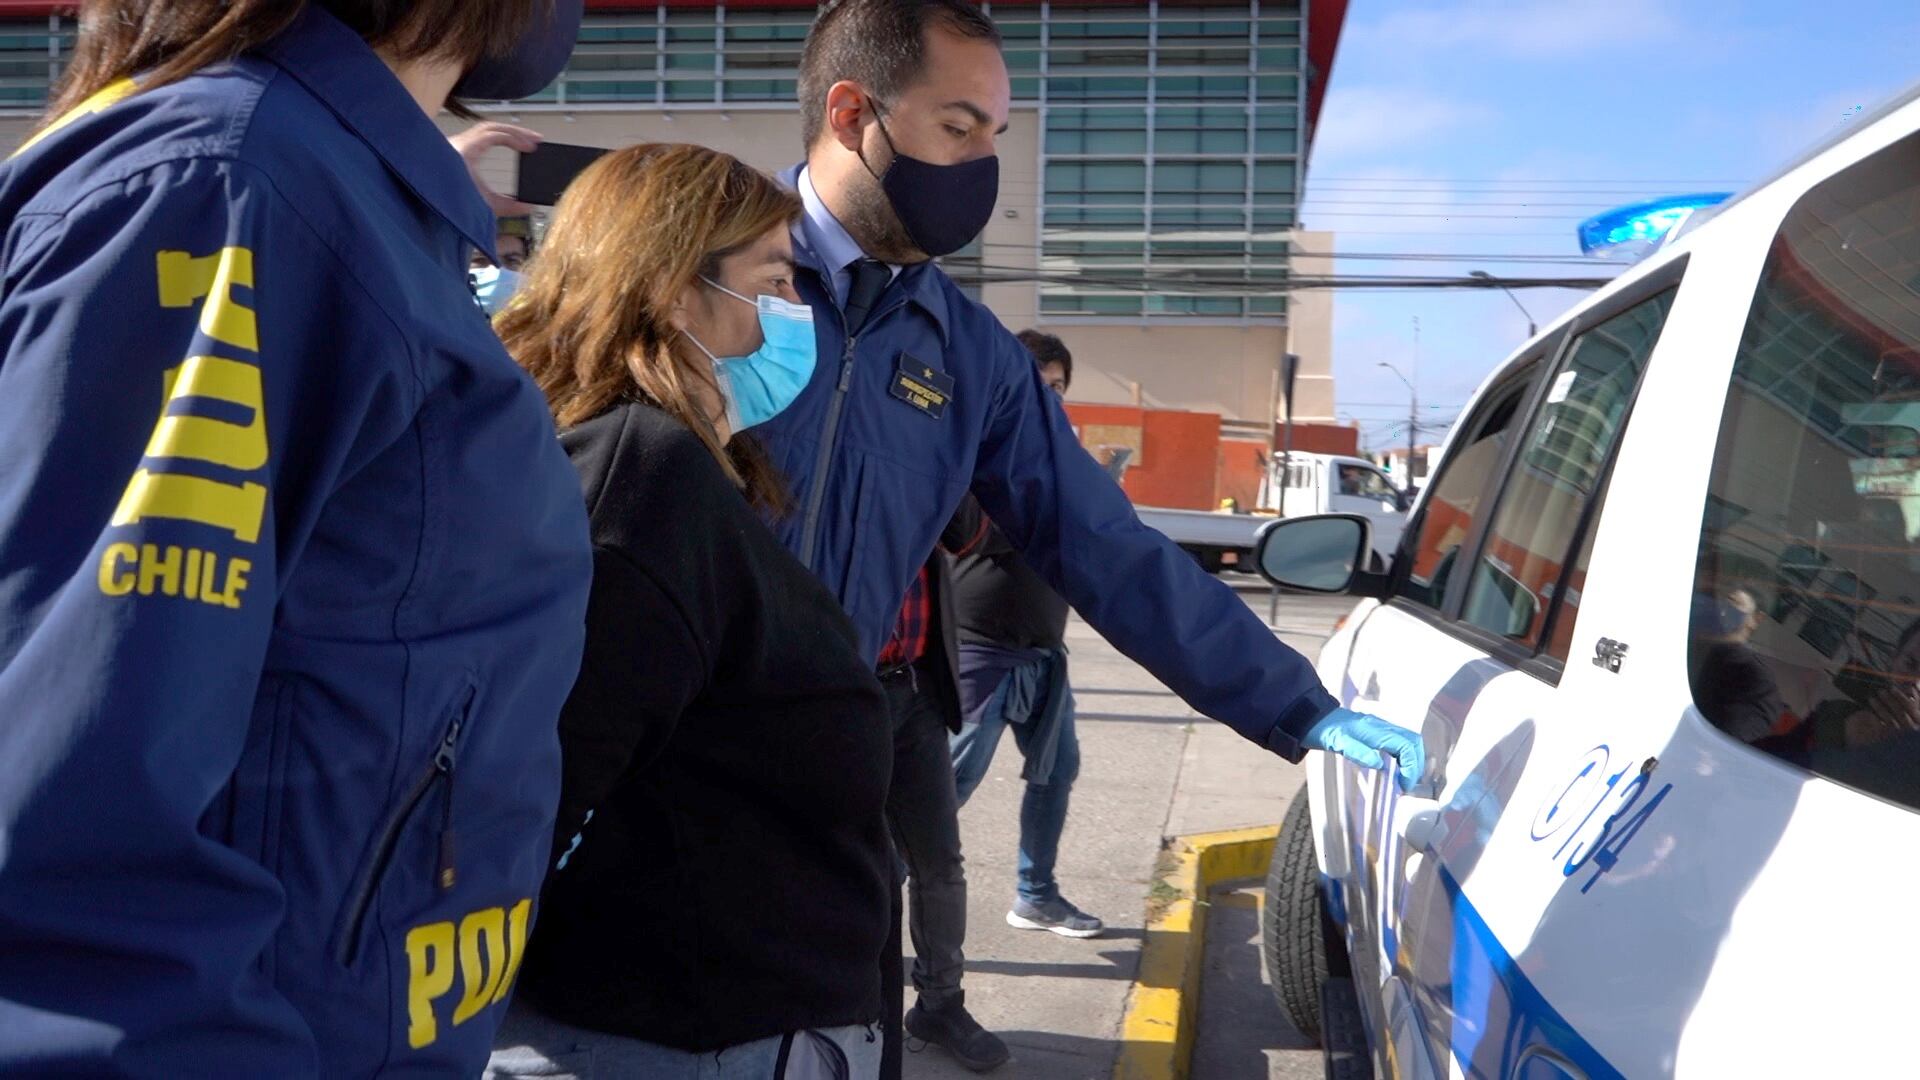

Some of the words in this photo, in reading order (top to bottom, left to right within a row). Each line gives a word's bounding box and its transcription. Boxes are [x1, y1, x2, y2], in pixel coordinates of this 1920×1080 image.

[111, 246, 269, 544] PDI
[97, 542, 252, 610] CHILE
[1552, 761, 1674, 895] 134
[405, 898, 533, 1050] PDI
